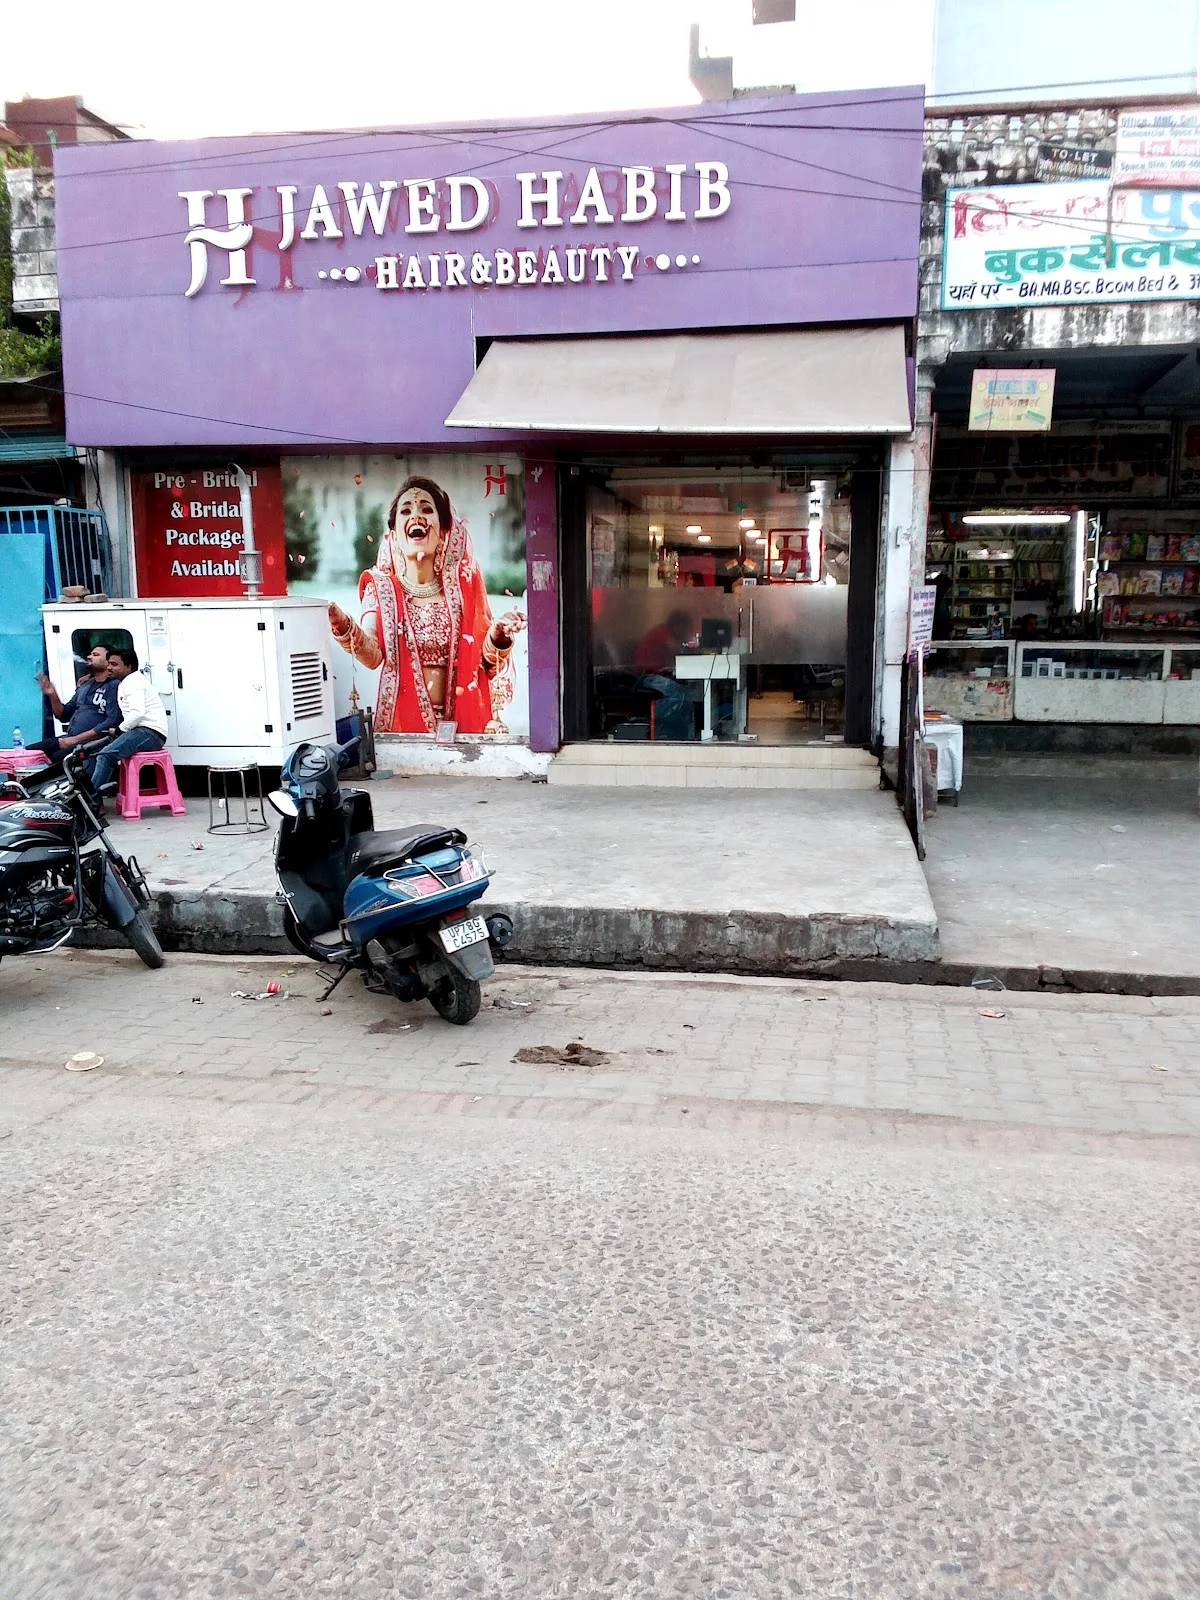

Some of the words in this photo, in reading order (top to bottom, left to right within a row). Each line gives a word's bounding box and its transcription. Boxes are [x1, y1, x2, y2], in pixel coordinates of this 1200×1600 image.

[1051, 147, 1099, 163] TO-LET
[276, 175, 491, 251] JAWED
[515, 161, 732, 229] HABIB
[374, 245, 640, 290] HAIR&BEAUTY
[980, 282, 1002, 301] पर
[154, 471, 186, 489] Pre
[171, 501, 184, 519] &
[10, 807, 73, 821] Passion
[449, 918, 480, 939] UP78G
[453, 927, 485, 949] C4575
